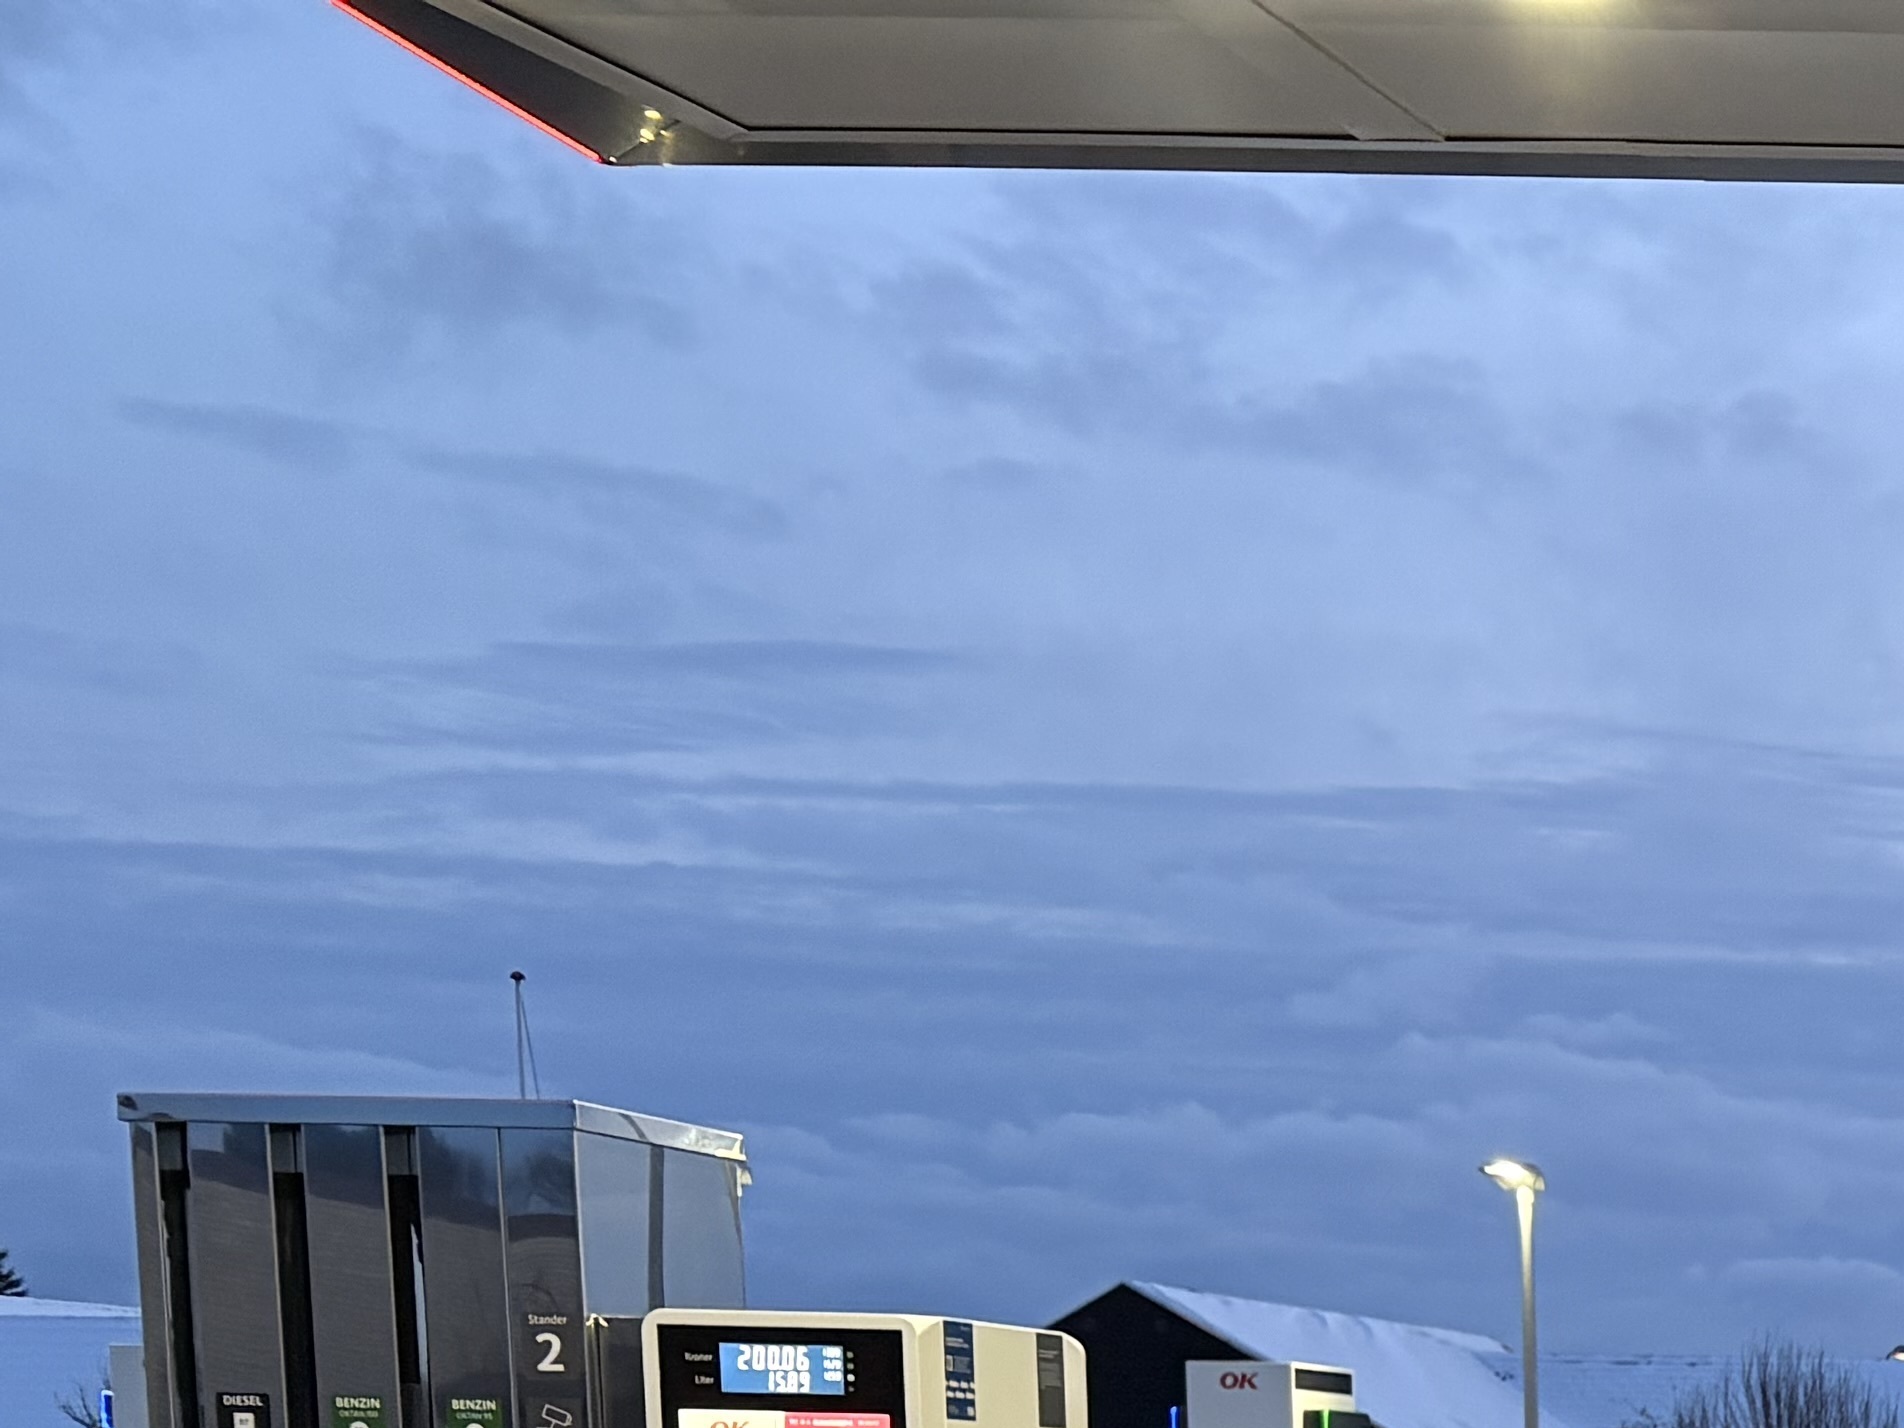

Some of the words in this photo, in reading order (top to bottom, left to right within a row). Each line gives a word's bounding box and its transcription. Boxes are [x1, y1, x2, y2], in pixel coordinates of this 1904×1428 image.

[528, 1314, 567, 1325] Stander
[535, 1332, 565, 1372] 2
[1220, 1371, 1258, 1390] OK
[222, 1394, 264, 1407] DIESEL
[335, 1397, 381, 1409] BENZIN
[451, 1399, 497, 1411] BENZIN
